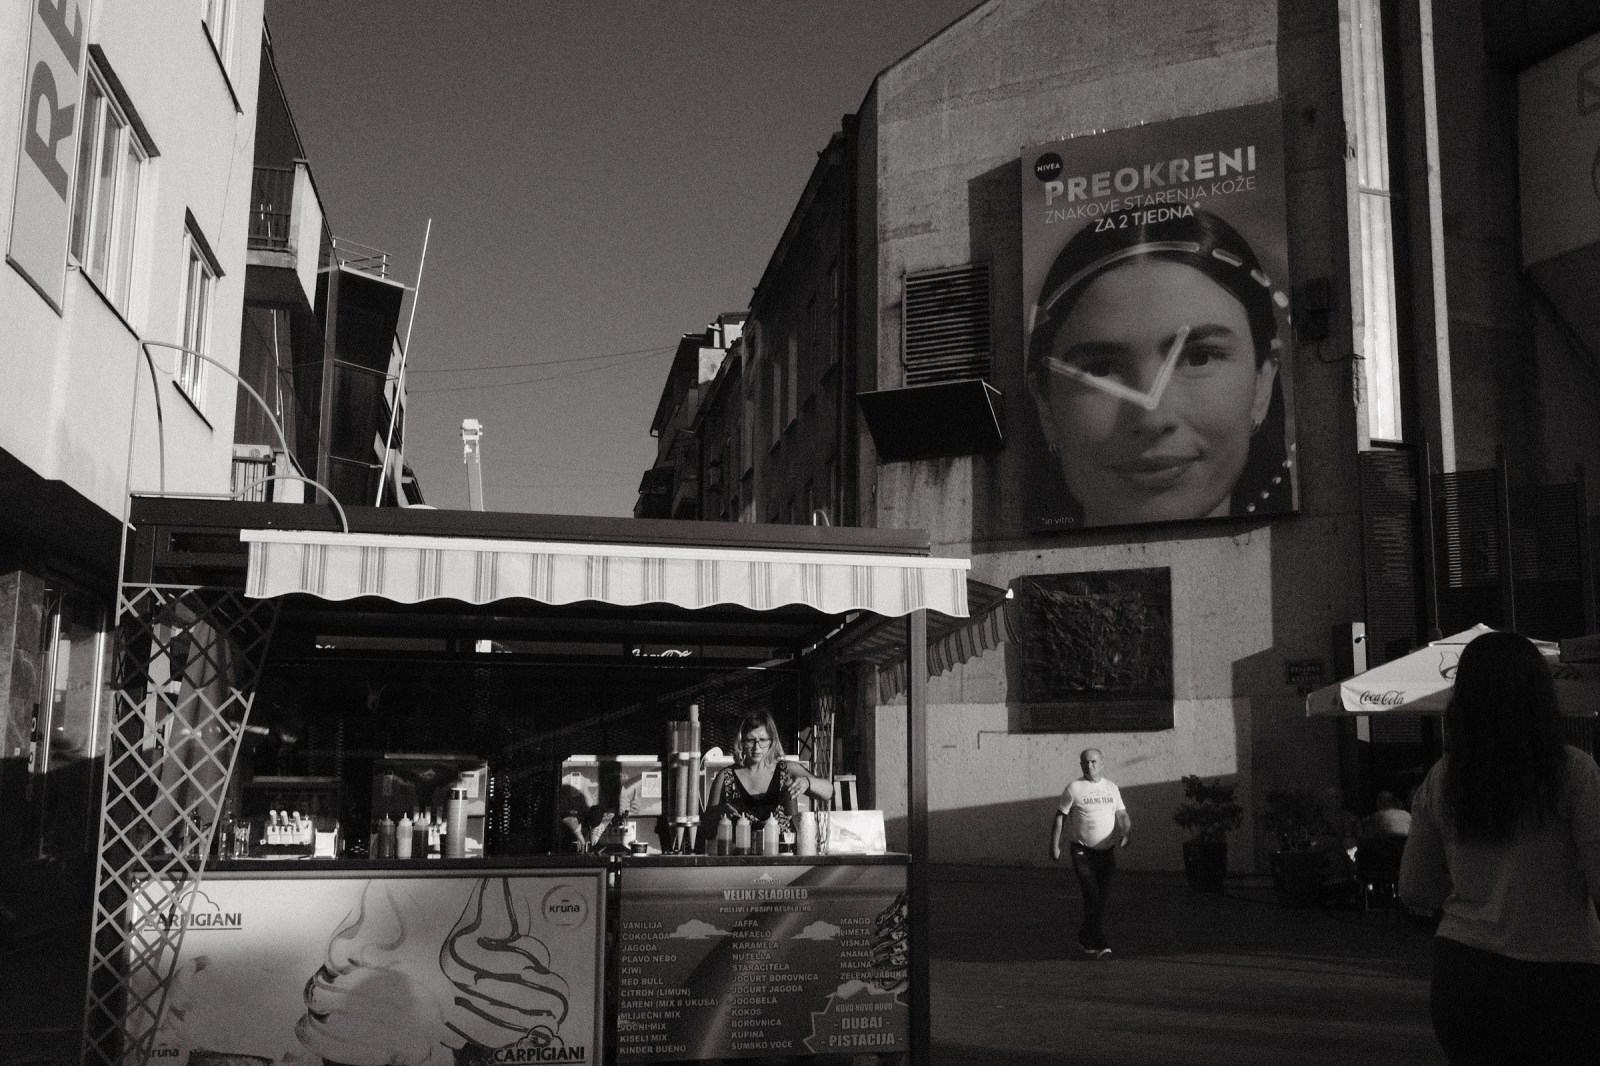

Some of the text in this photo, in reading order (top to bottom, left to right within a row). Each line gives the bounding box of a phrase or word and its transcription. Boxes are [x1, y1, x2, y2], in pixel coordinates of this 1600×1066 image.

[1036, 162, 1061, 173] NIVEA
[1044, 145, 1256, 206] PREOKRENI
[1045, 174, 1256, 225] ZNAKOVE STARENJA KOŽE
[1094, 217, 1116, 233] ZA
[1119, 213, 1128, 229] 2
[723, 888, 809, 901] VELIKI SLADOLED
[622, 921, 662, 929] VANILIJA
[733, 919, 759, 927] JAFFA
[732, 930, 771, 938] RAFAELO
[840, 928, 870, 936] LIMETA
[621, 944, 657, 952] JAGODA
[840, 950, 874, 958] ANANAS
[621, 955, 650, 963] PLAVO
[621, 966, 642, 974] KIWI
[732, 973, 819, 983] JOGURT BOROVNICA
[840, 971, 872, 980] ZELENA
[621, 977, 664, 986] RED BULL
[620, 988, 691, 998] CITRON (LIMUN)
[731, 984, 803, 994] JOGURT JAGODA
[655, 999, 675, 1008] (MIX
[685, 998, 719, 1007] UKUSA)
[731, 996, 778, 1005] JOGOBELA
[835, 1002, 893, 1012] NOVO NOVO NOVO
[731, 1008, 762, 1016] KOKOS
[731, 1018, 782, 1028] BOROVNICA
[841, 1016, 882, 1029] DUBAI
[619, 1034, 667, 1043] KISELI MIX
[731, 1030, 764, 1039] KUPINA
[829, 1032, 895, 1047] PISTACIJA
[494, 1046, 585, 1062] CARPIGIANI
[619, 1045, 686, 1054] KINDER BUENO
